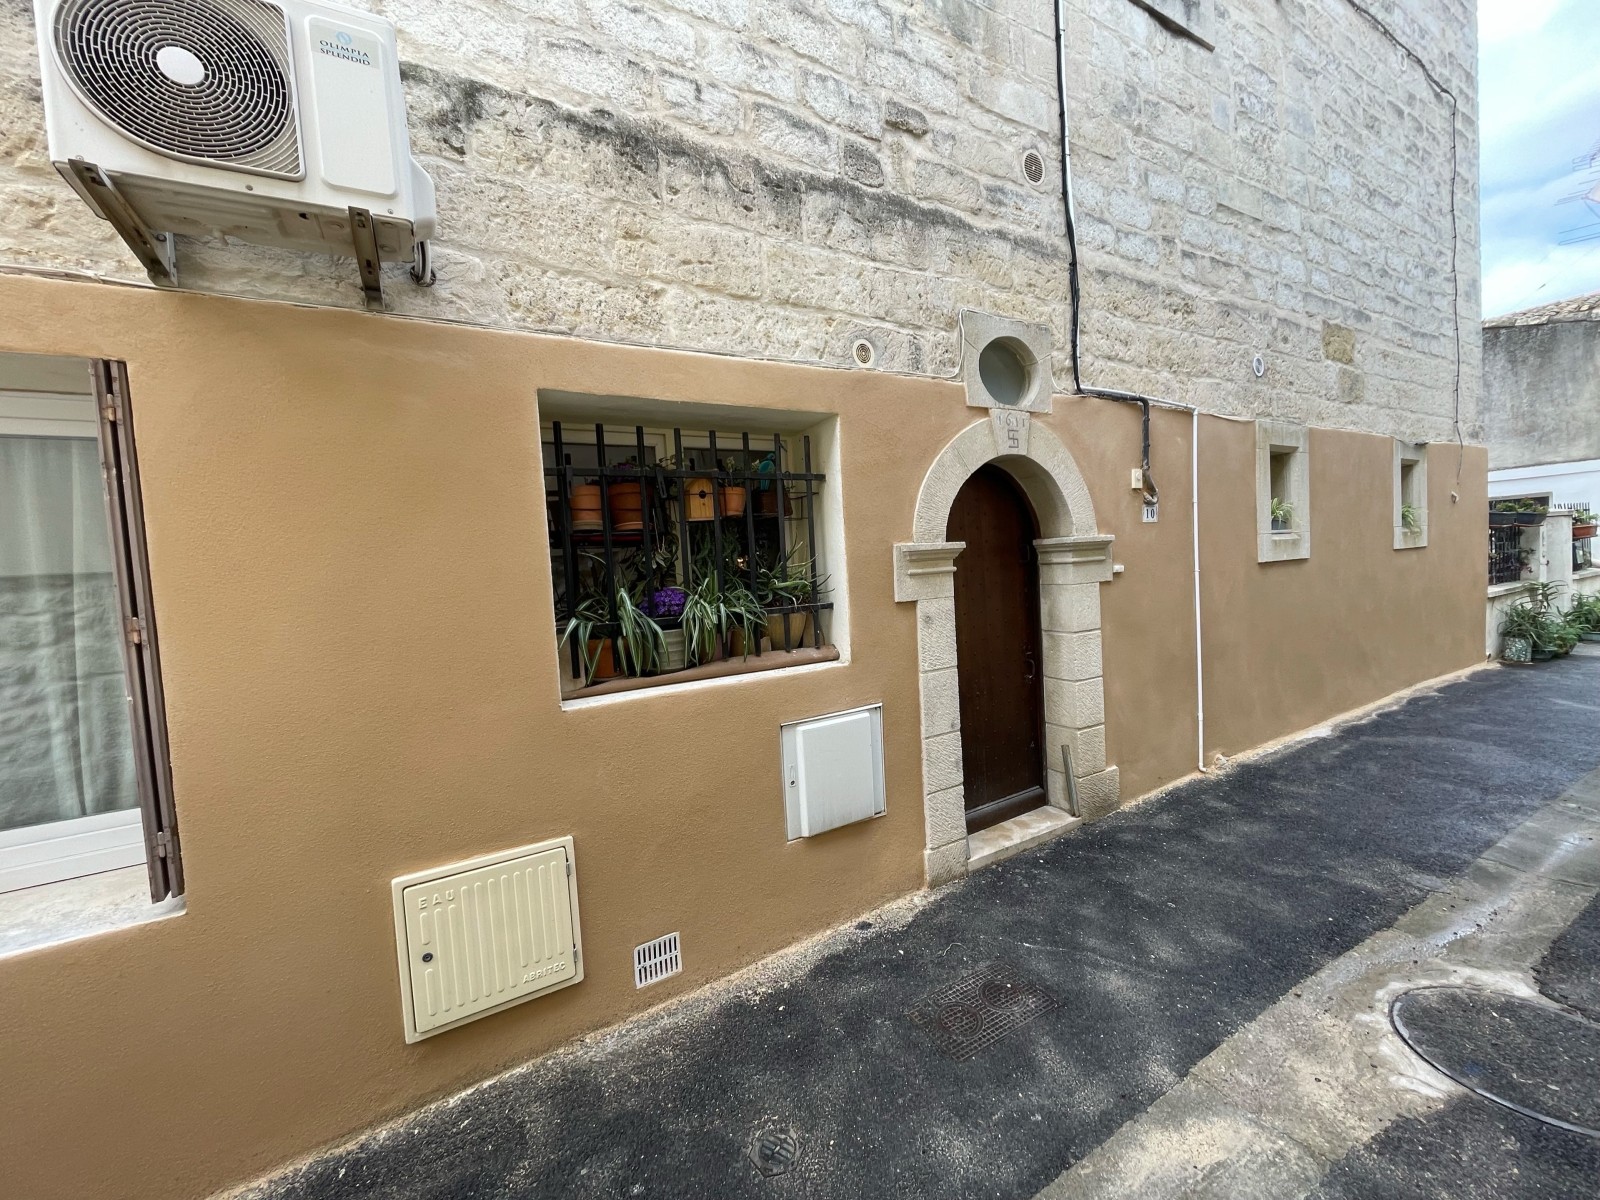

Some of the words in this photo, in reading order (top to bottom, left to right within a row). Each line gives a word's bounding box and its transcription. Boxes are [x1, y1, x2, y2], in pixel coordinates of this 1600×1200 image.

[319, 40, 370, 58] OLIMPIA
[320, 48, 371, 66] SPLENDID
[1146, 508, 1155, 519] 10
[418, 889, 456, 910] EAU
[522, 961, 567, 984] ABRITEC
